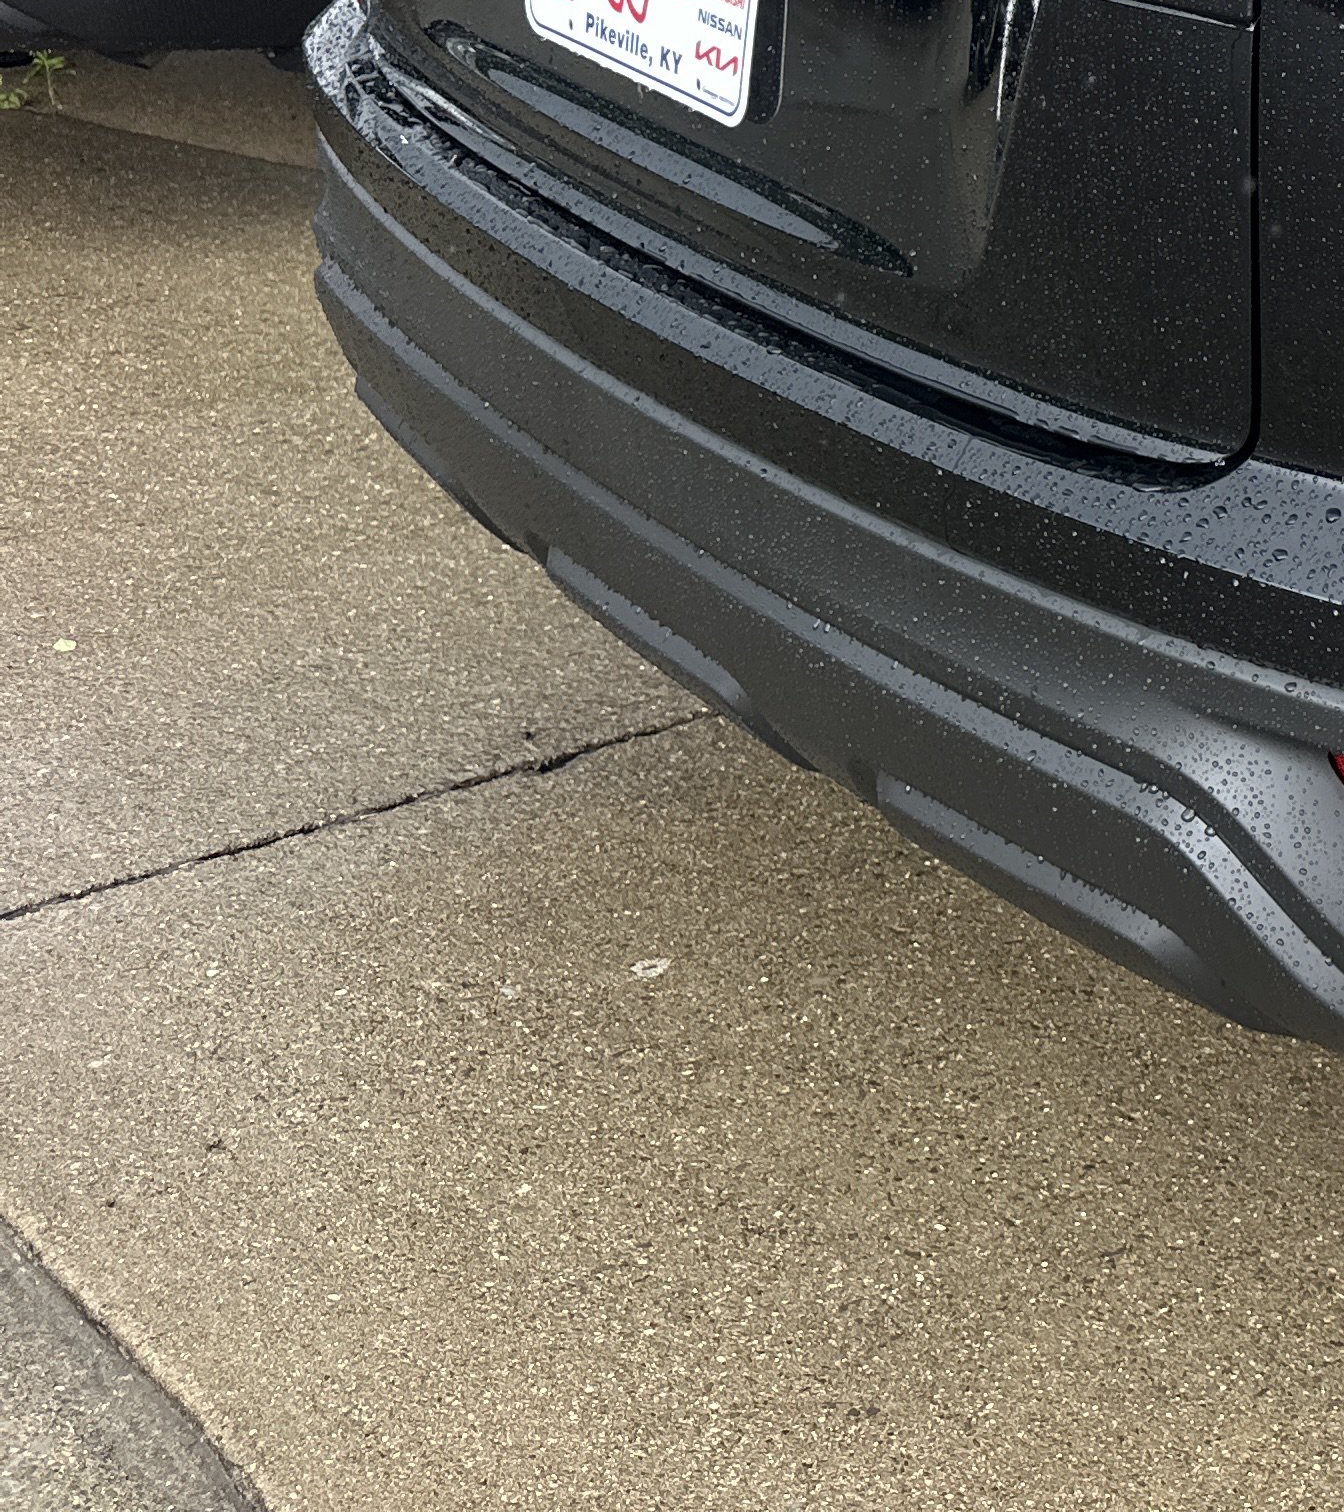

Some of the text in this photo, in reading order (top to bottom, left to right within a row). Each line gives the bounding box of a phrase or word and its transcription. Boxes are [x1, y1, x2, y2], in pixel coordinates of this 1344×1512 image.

[585, 12, 683, 74] Pikeville, KY
[698, 8, 743, 40] NISSAN
